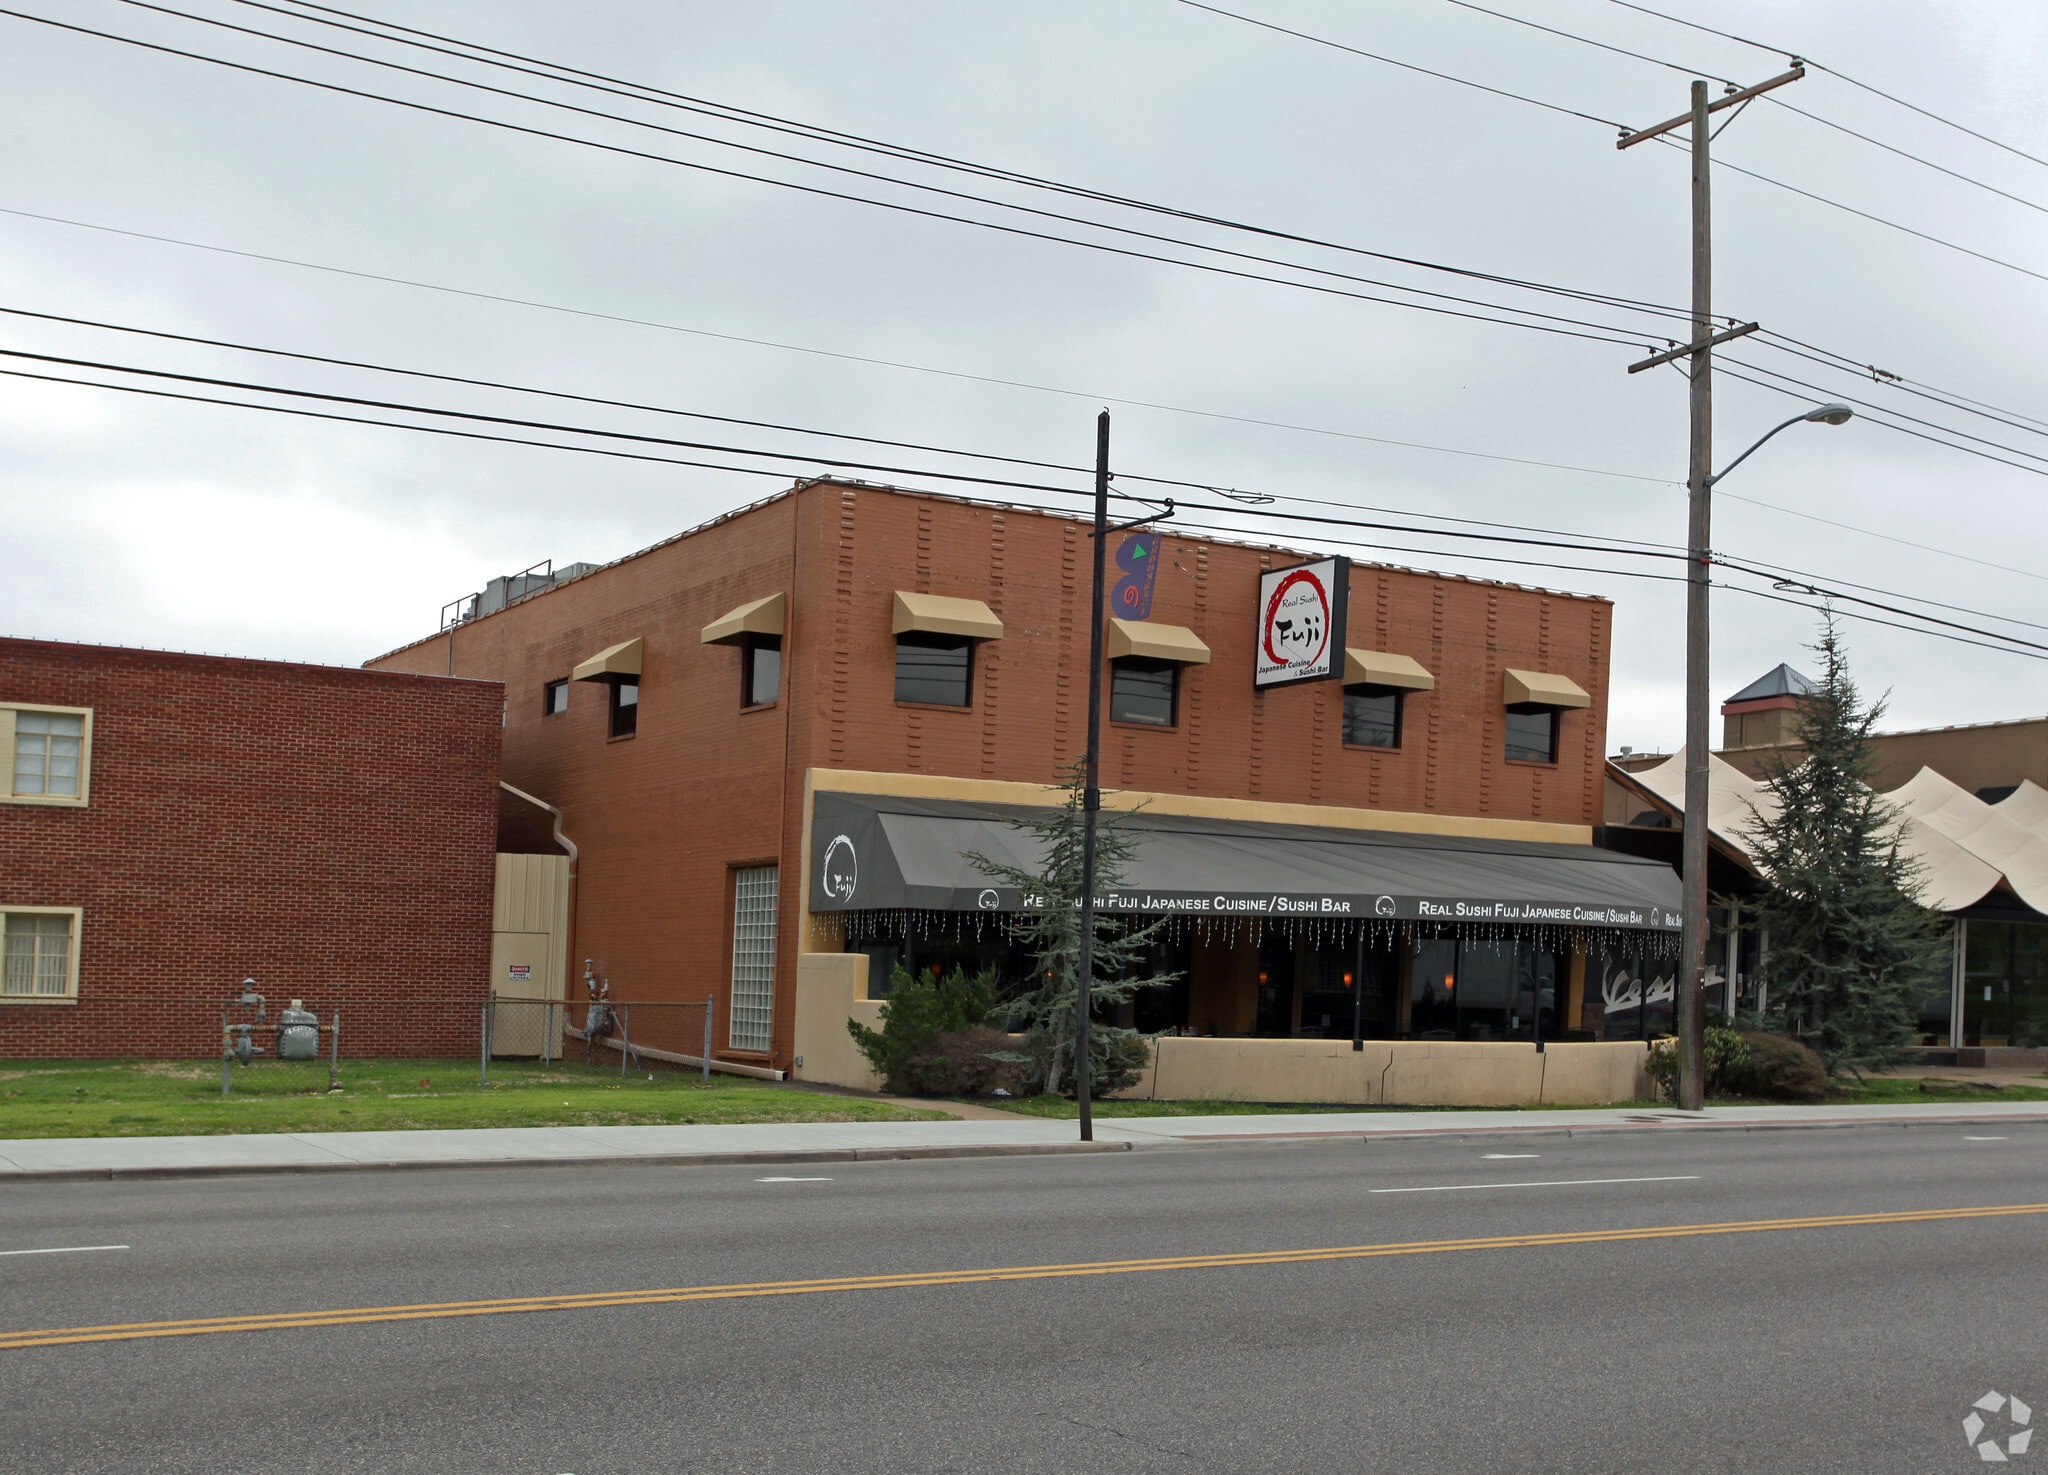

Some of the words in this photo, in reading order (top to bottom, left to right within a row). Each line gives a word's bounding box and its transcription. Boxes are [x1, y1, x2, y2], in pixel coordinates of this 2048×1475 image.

[1282, 597, 1299, 608] Real
[1300, 593, 1319, 605] Sushi
[1275, 616, 1320, 647] Fuji
[1258, 663, 1287, 674] Japanese
[1287, 659, 1311, 670] Cuisine
[1299, 667, 1317, 676] Sushi
[834, 874, 852, 897] Fuji
[1108, 894, 1138, 909] FUJI
[1141, 895, 1210, 911] JAPANESE
[1321, 898, 1350, 913] BAR
[1418, 901, 1453, 915] REAL
[1455, 903, 1492, 917] SUSHI
[1494, 904, 1519, 918] FUJI
[1521, 905, 1571, 919] JAPANESE
[1629, 911, 1643, 924] BAR
